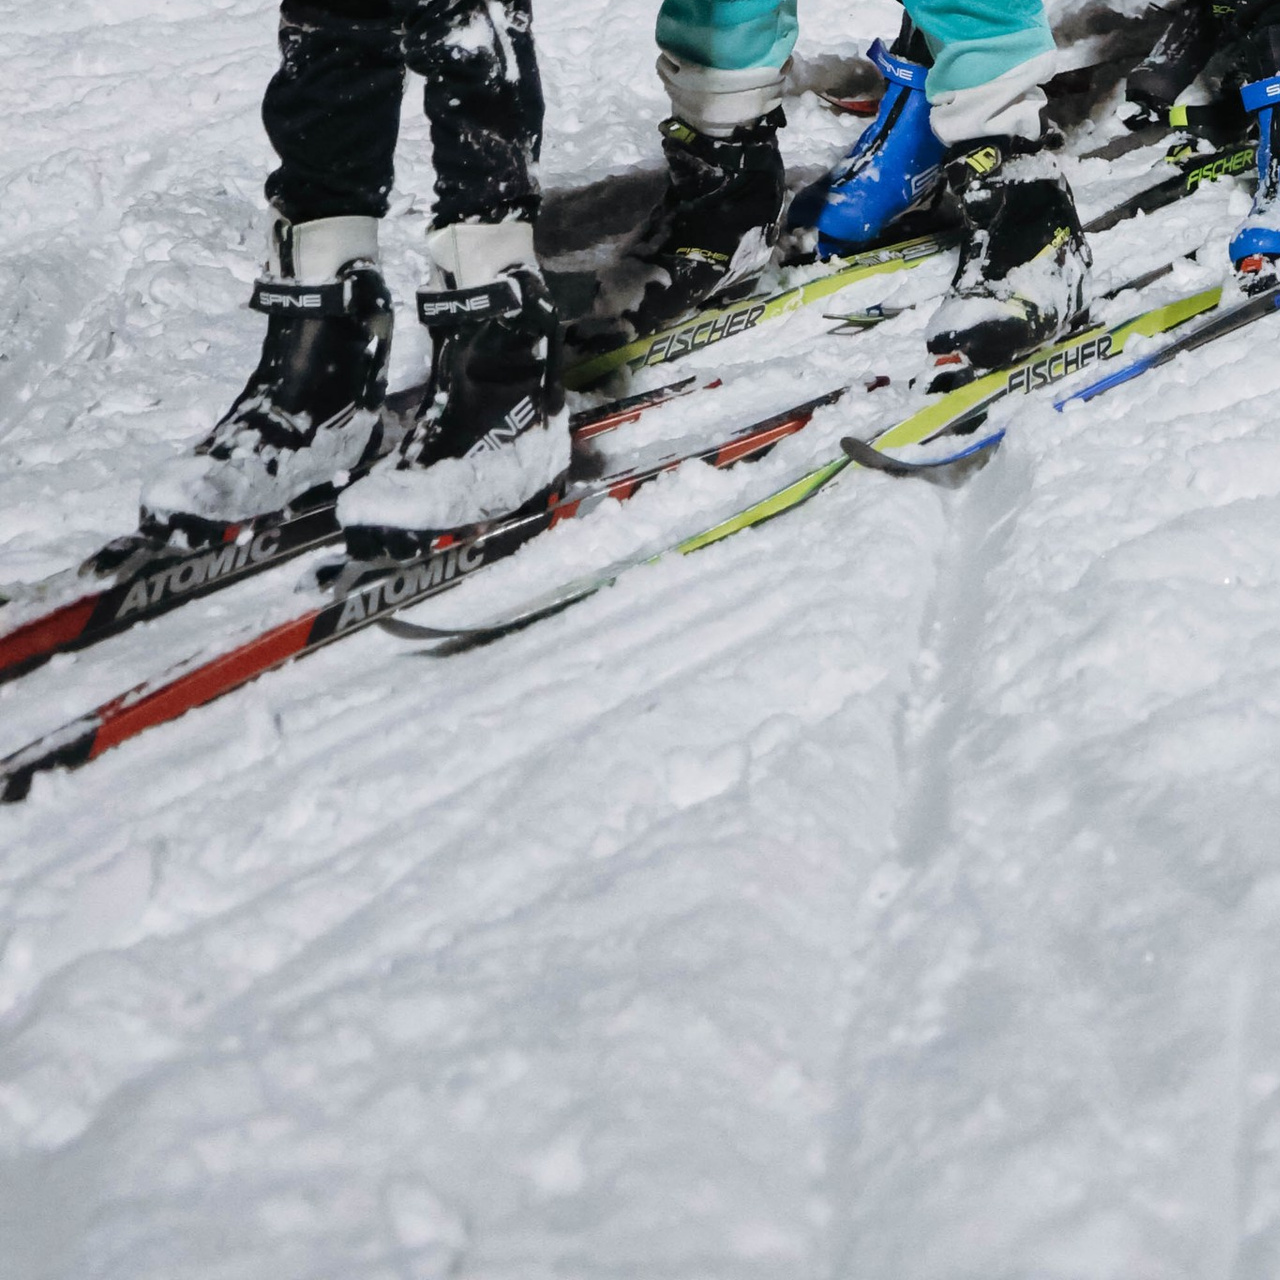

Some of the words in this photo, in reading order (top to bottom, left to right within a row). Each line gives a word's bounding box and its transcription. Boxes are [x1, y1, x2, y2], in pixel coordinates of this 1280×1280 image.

[259, 292, 321, 308] SPINE
[423, 294, 490, 316] SPINE
[644, 304, 767, 367] FISCHER
[1007, 335, 1114, 395] FISCHER
[115, 527, 282, 620] ATOMIC
[336, 540, 485, 631] ATOMIC
